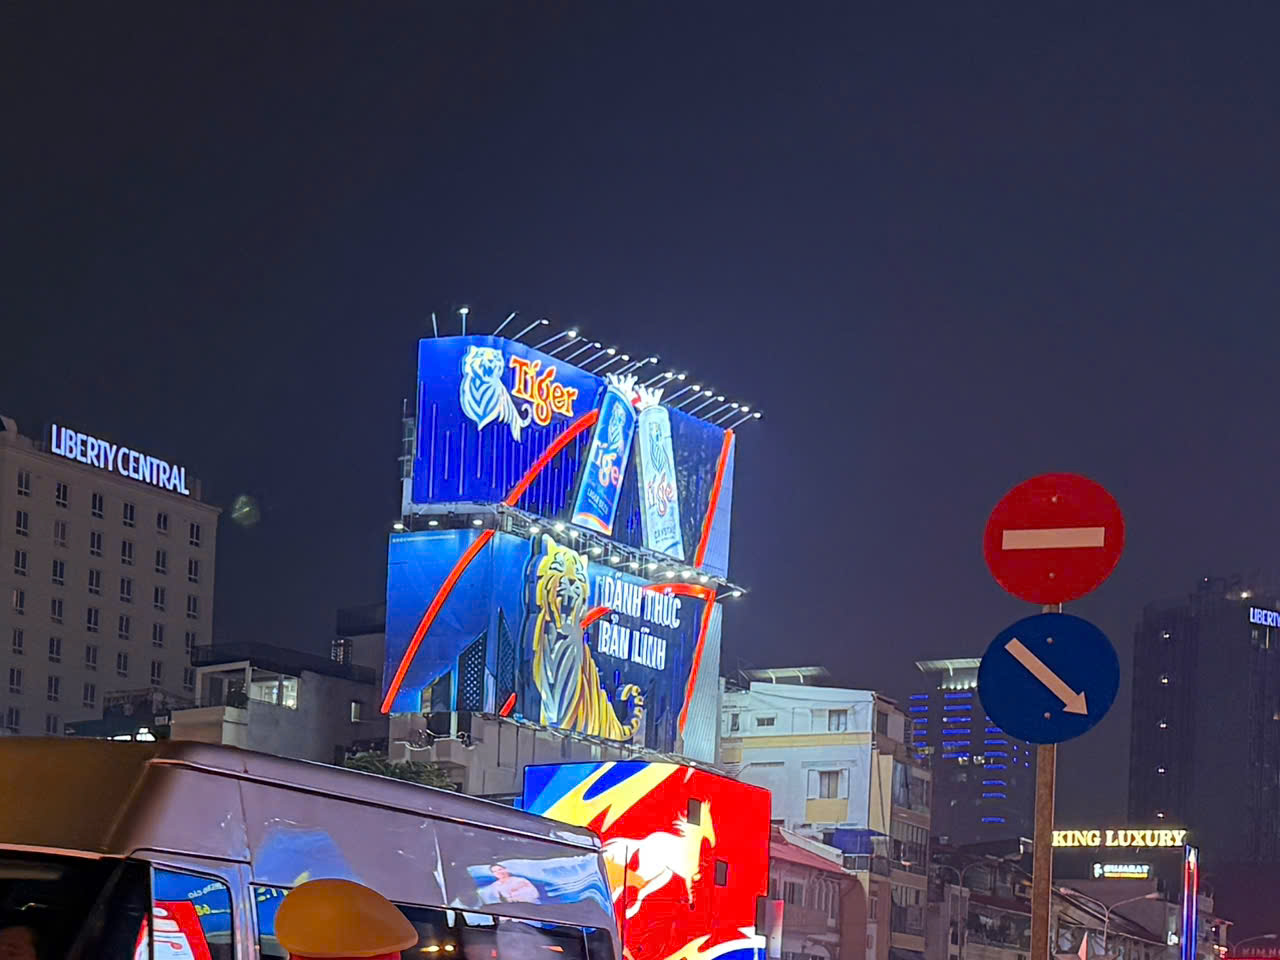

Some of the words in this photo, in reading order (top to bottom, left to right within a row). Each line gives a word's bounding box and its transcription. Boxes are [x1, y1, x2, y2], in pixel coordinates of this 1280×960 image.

[510, 355, 579, 426] Tiger
[51, 424, 117, 472] LIBERTY
[117, 447, 190, 496] CENTRAL
[1051, 829, 1102, 847] KING
[1105, 829, 1187, 847] LUXURY
